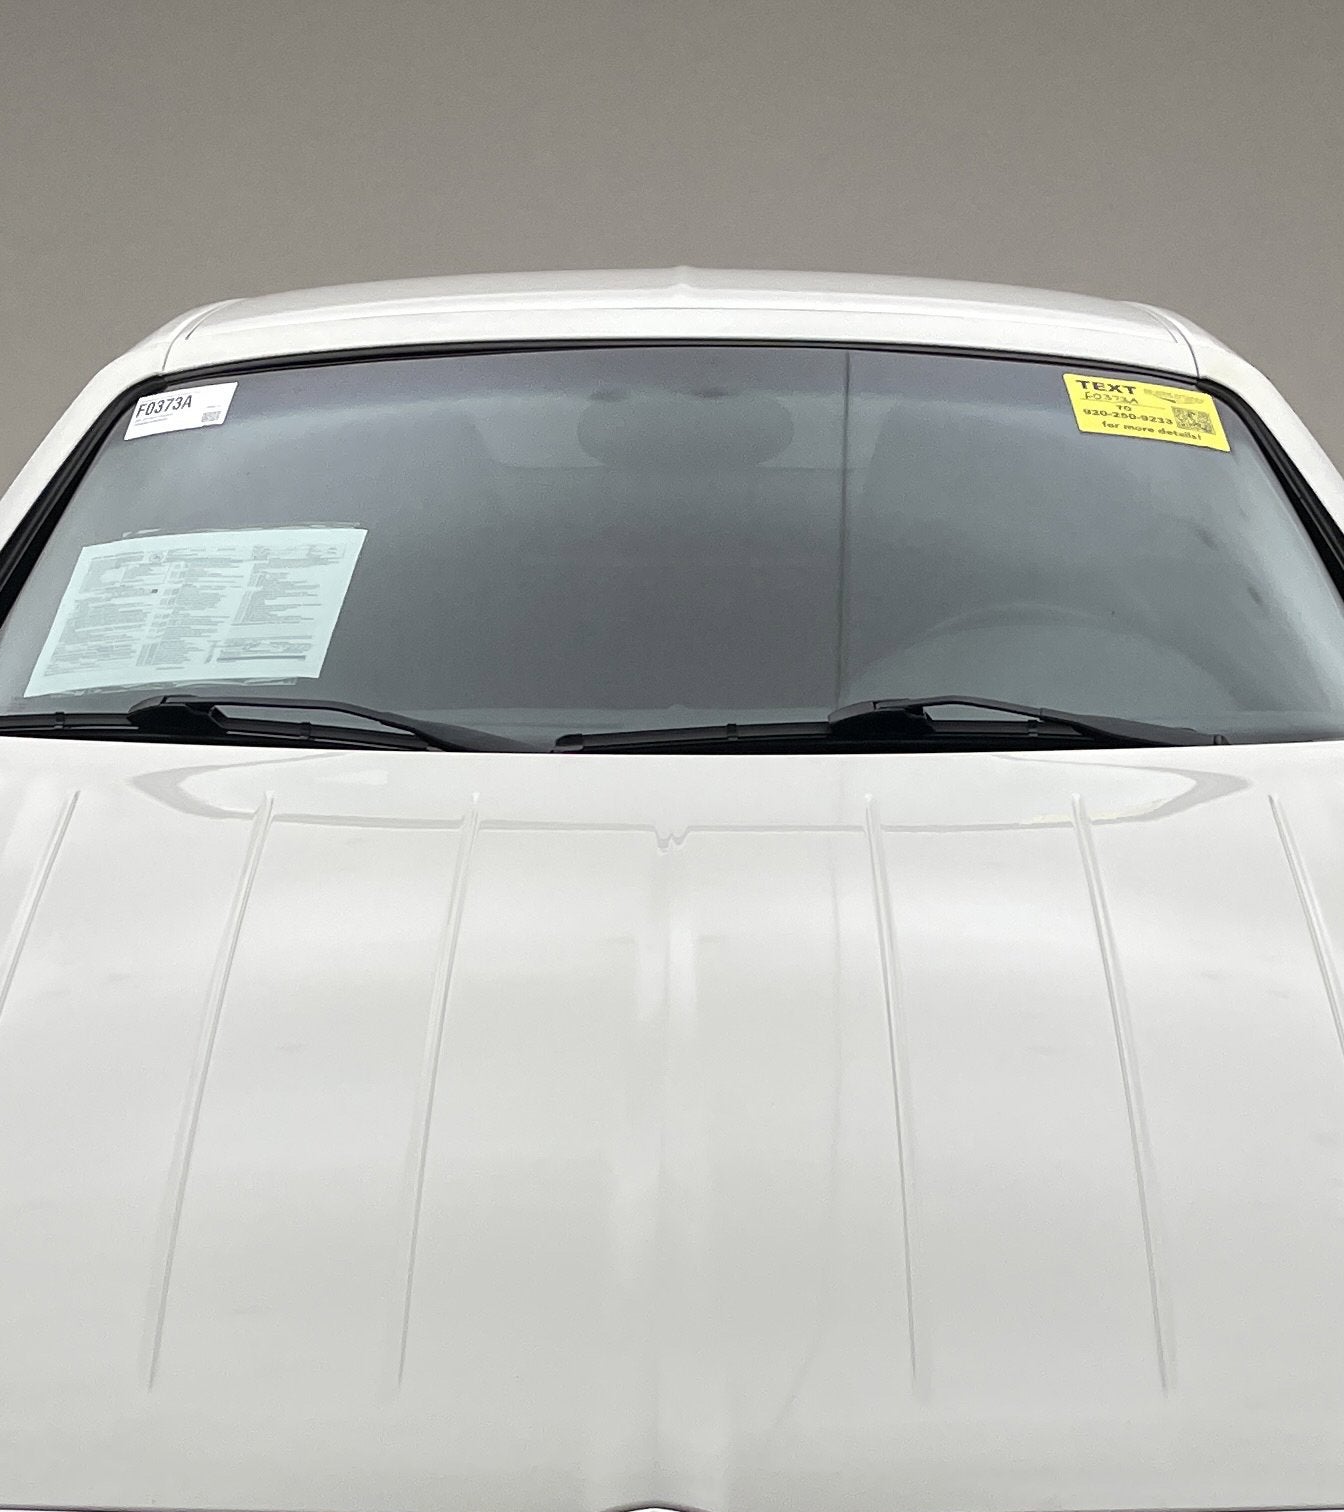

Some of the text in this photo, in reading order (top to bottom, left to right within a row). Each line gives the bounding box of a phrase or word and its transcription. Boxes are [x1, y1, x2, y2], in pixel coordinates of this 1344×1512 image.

[1076, 379, 1137, 395] TEXT
[135, 394, 192, 418] F0373A
[1102, 420, 1119, 430] for
[1124, 424, 1155, 434] more
